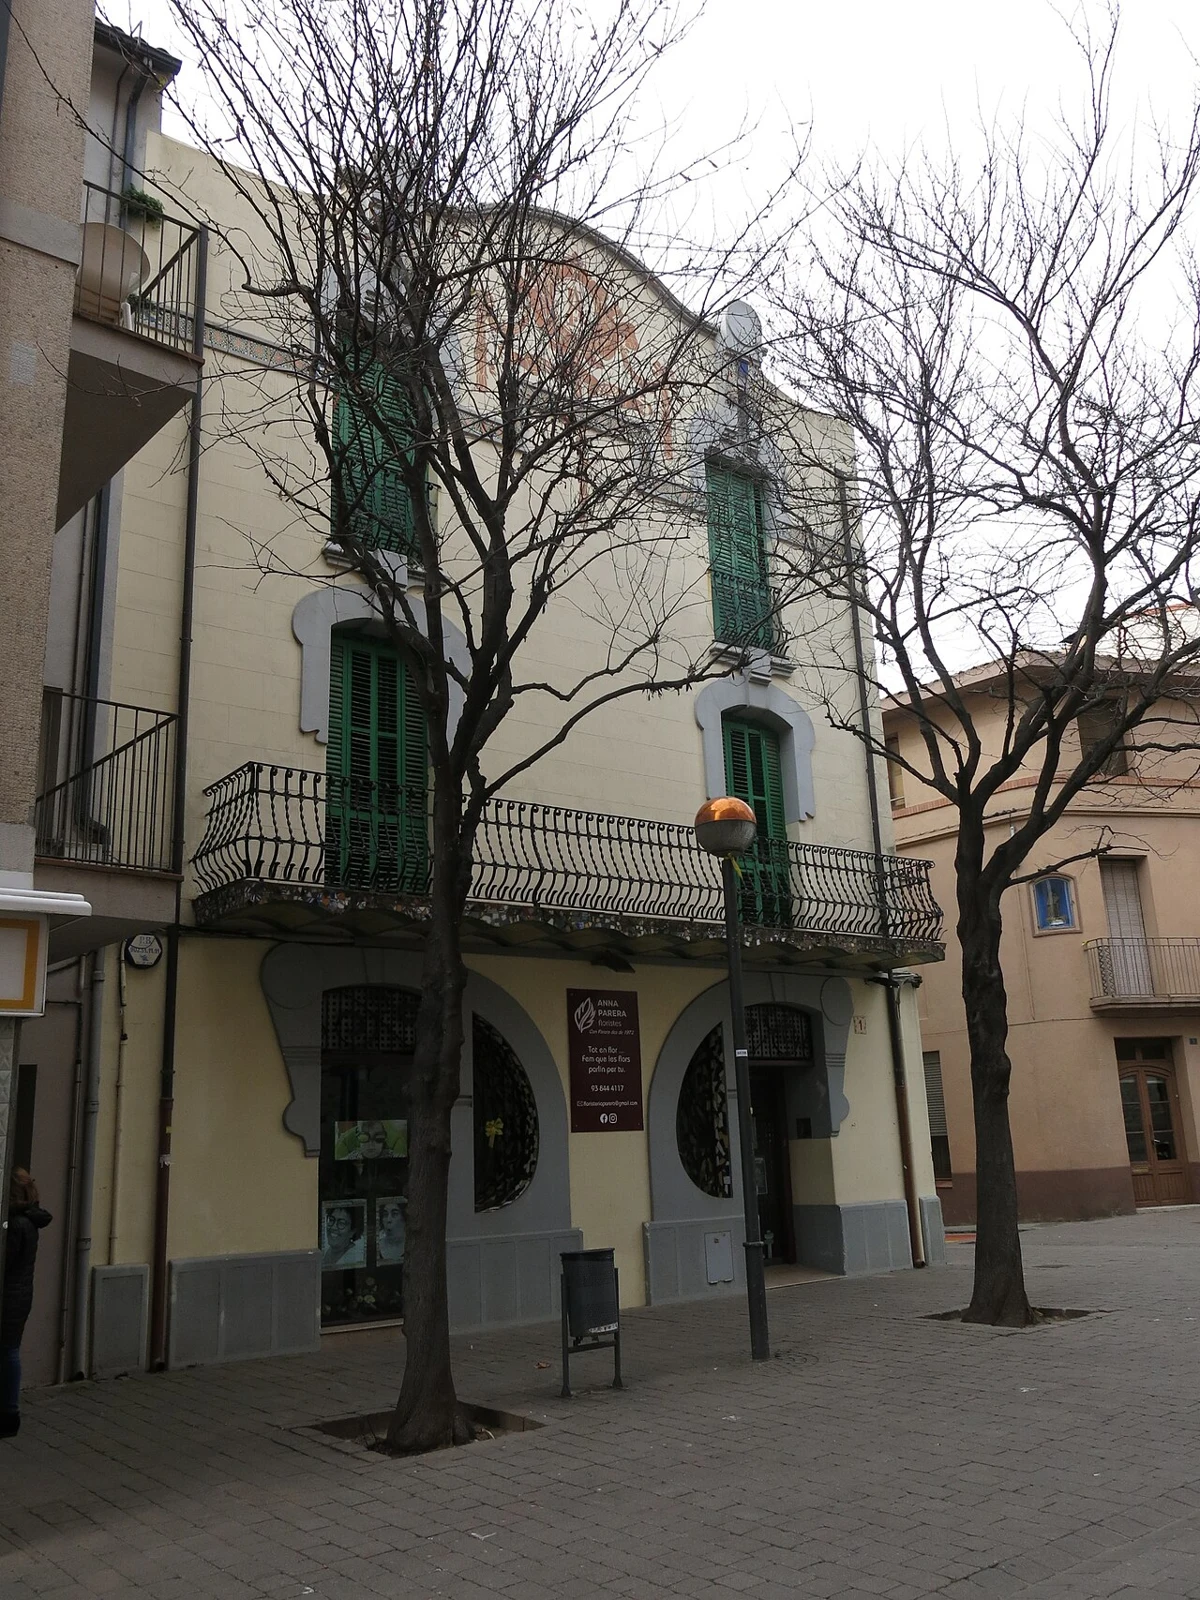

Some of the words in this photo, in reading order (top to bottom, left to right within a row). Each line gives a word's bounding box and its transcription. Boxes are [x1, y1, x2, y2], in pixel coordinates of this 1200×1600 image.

[597, 999, 619, 1007] ANNA
[598, 1009, 627, 1018] PARERA
[598, 1019, 622, 1027] floristes
[588, 1045, 598, 1053] Tot
[608, 1046, 618, 1054] flor
[581, 1054, 595, 1062] Fem
[595, 1056, 607, 1064] que
[608, 1055, 617, 1063] les
[618, 1055, 631, 1063] flors
[588, 1065, 606, 1074] parlin
[606, 1066, 616, 1075] per
[591, 1084, 598, 1092] 93
[610, 1084, 624, 1092] 4117
